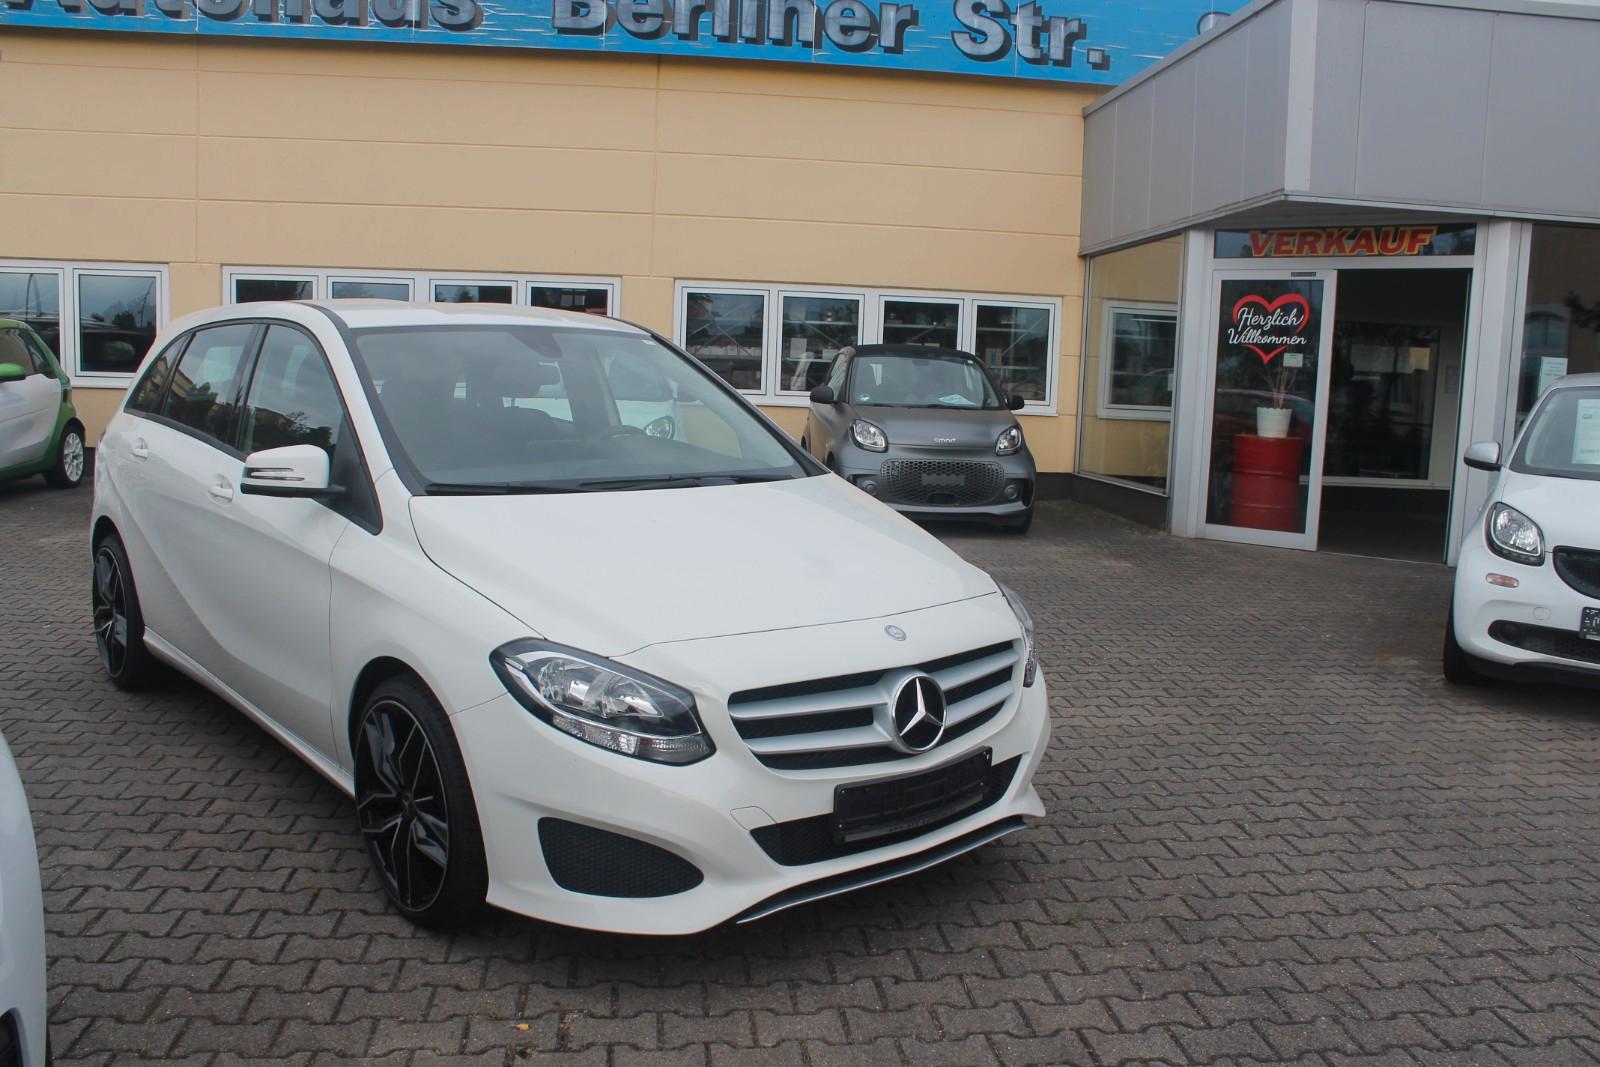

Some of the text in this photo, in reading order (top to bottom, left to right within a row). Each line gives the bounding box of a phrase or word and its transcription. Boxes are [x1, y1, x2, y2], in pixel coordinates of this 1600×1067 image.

[951, 0, 1109, 69] Str.
[1249, 226, 1438, 257] VERKAUF
[1237, 306, 1305, 331] Herzlich
[1227, 326, 1308, 345] Willkommen
